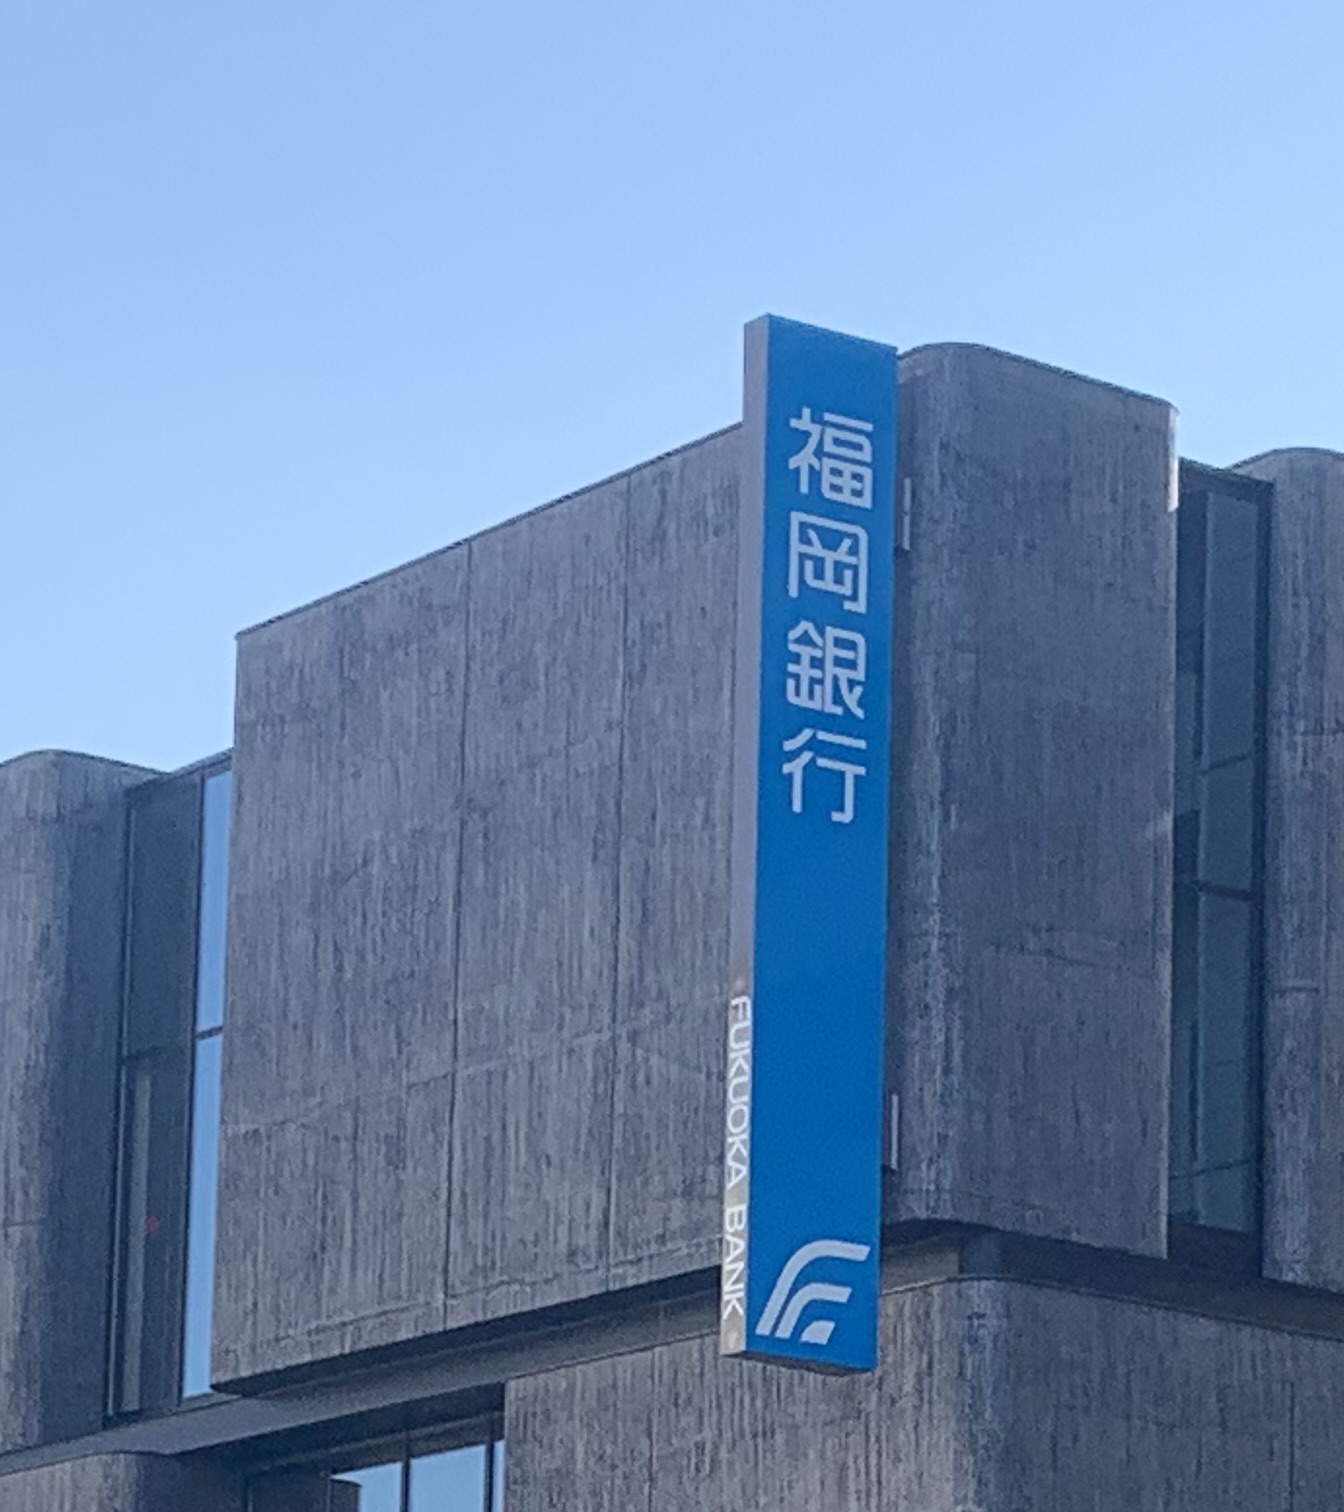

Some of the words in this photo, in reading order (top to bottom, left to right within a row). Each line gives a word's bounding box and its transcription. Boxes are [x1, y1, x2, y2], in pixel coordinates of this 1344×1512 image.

[782, 406, 874, 824] 福岡銀行
[726, 995, 752, 1190] FUKUOKA
[722, 1205, 748, 1320] BANK
